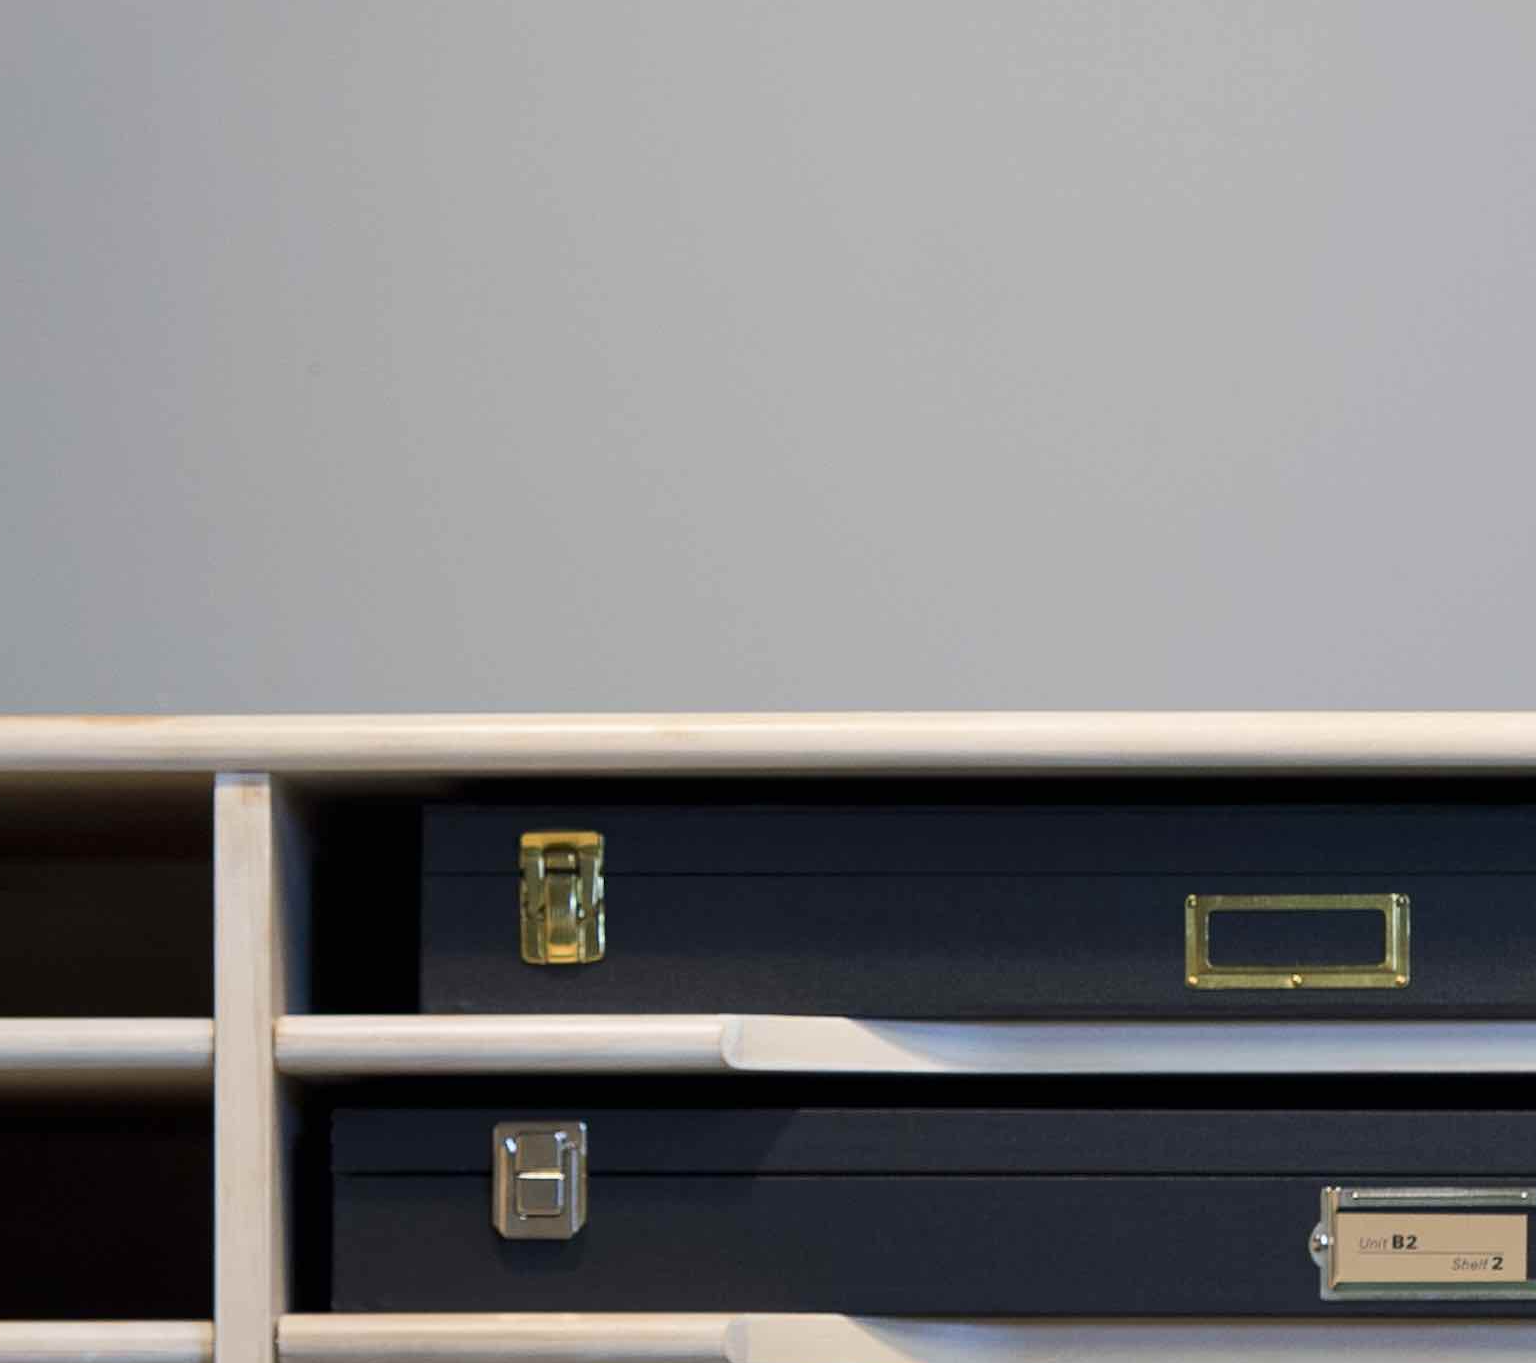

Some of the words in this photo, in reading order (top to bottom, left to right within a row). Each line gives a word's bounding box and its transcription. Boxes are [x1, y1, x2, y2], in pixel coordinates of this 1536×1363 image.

[1359, 1236, 1390, 1250] Unit
[1392, 1235, 1417, 1250] B2
[1451, 1257, 1488, 1271] Shelf
[1492, 1257, 1503, 1270] 2
